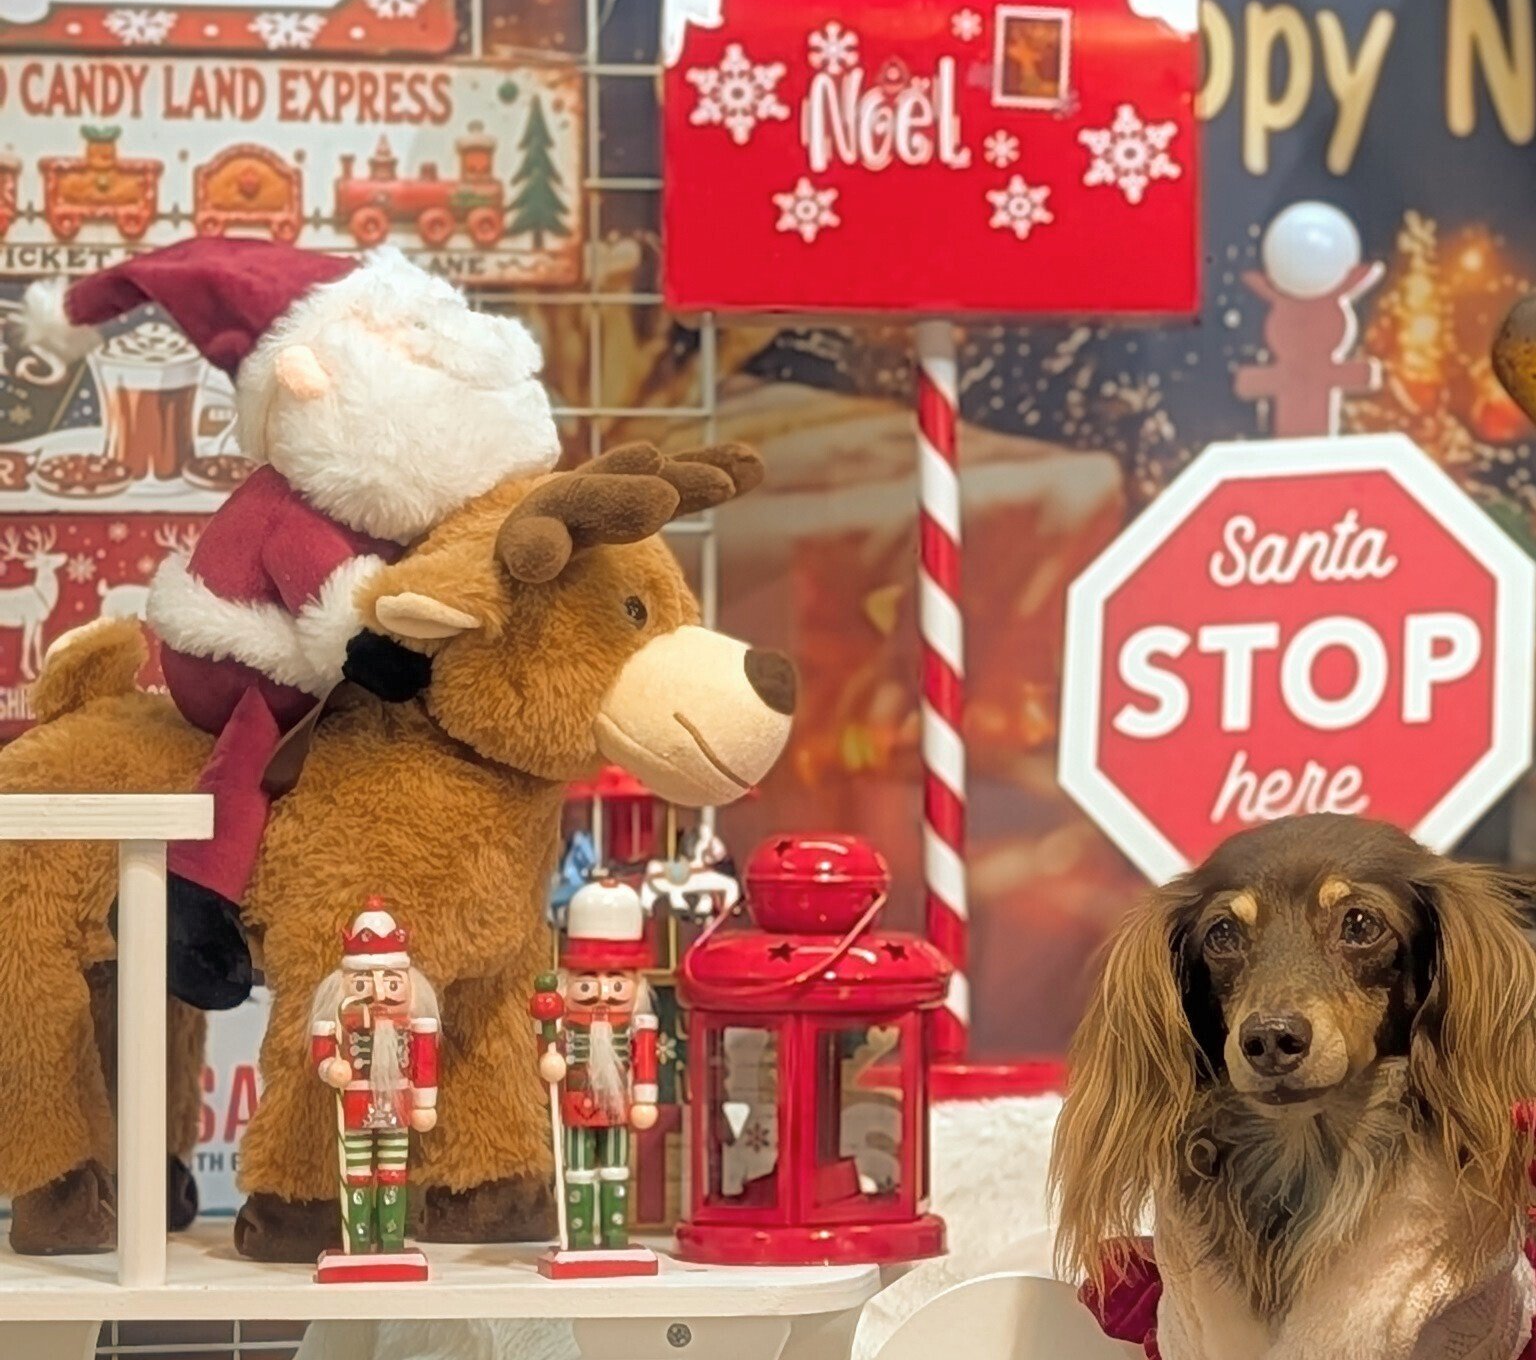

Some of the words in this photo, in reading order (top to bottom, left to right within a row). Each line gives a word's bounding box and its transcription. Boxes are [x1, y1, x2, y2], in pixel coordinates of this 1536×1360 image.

[20, 63, 149, 119] CANDY
[163, 65, 266, 121] LAND
[278, 68, 453, 125] EXPRESS
[1210, 509, 1397, 586] Santa
[1113, 612, 1482, 739] STOP
[1210, 750, 1369, 823] here
